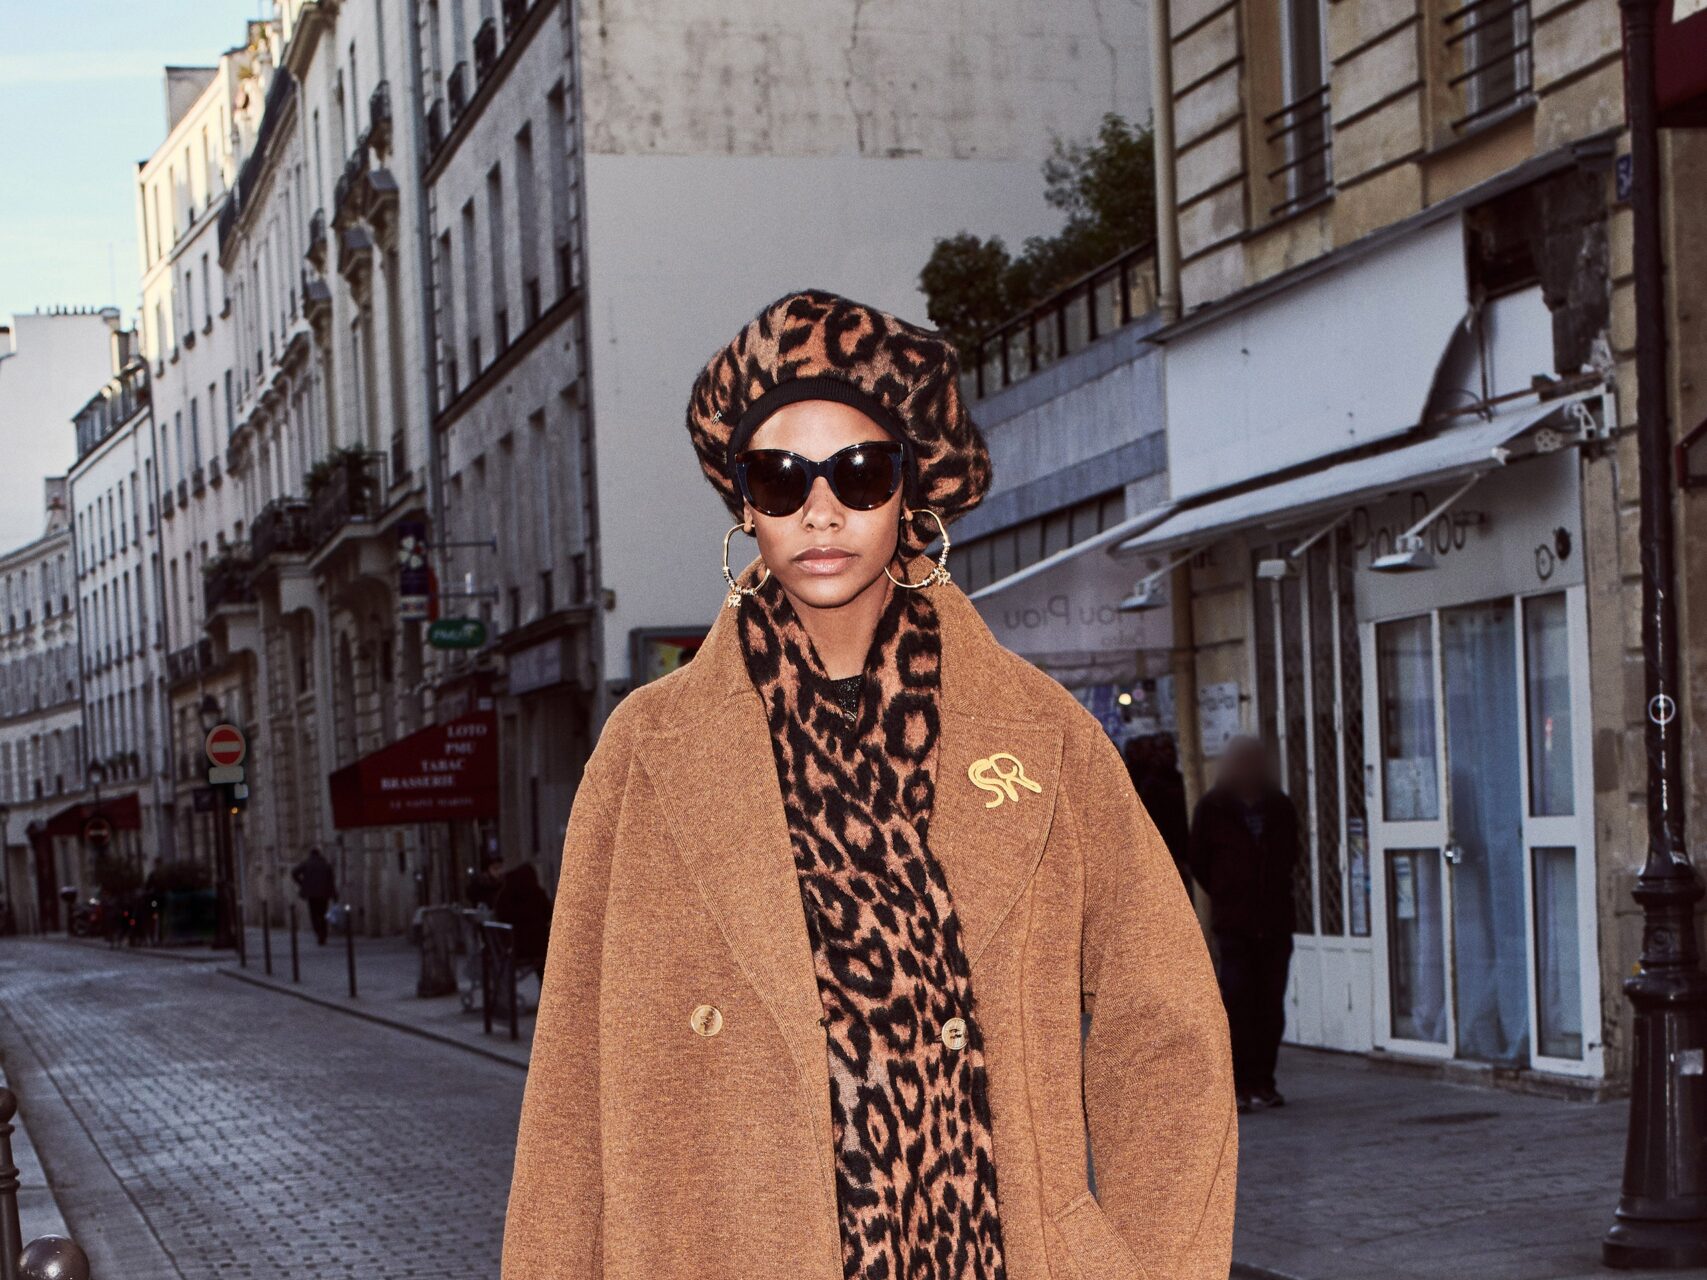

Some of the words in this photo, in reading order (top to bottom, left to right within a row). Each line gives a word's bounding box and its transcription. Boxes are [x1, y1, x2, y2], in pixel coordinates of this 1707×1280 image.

[447, 725, 487, 738] LOTO
[445, 742, 475, 754] PMU
[421, 758, 465, 772] TABAC
[381, 775, 455, 790] BRASSERIE
[968, 753, 1042, 808] SR
